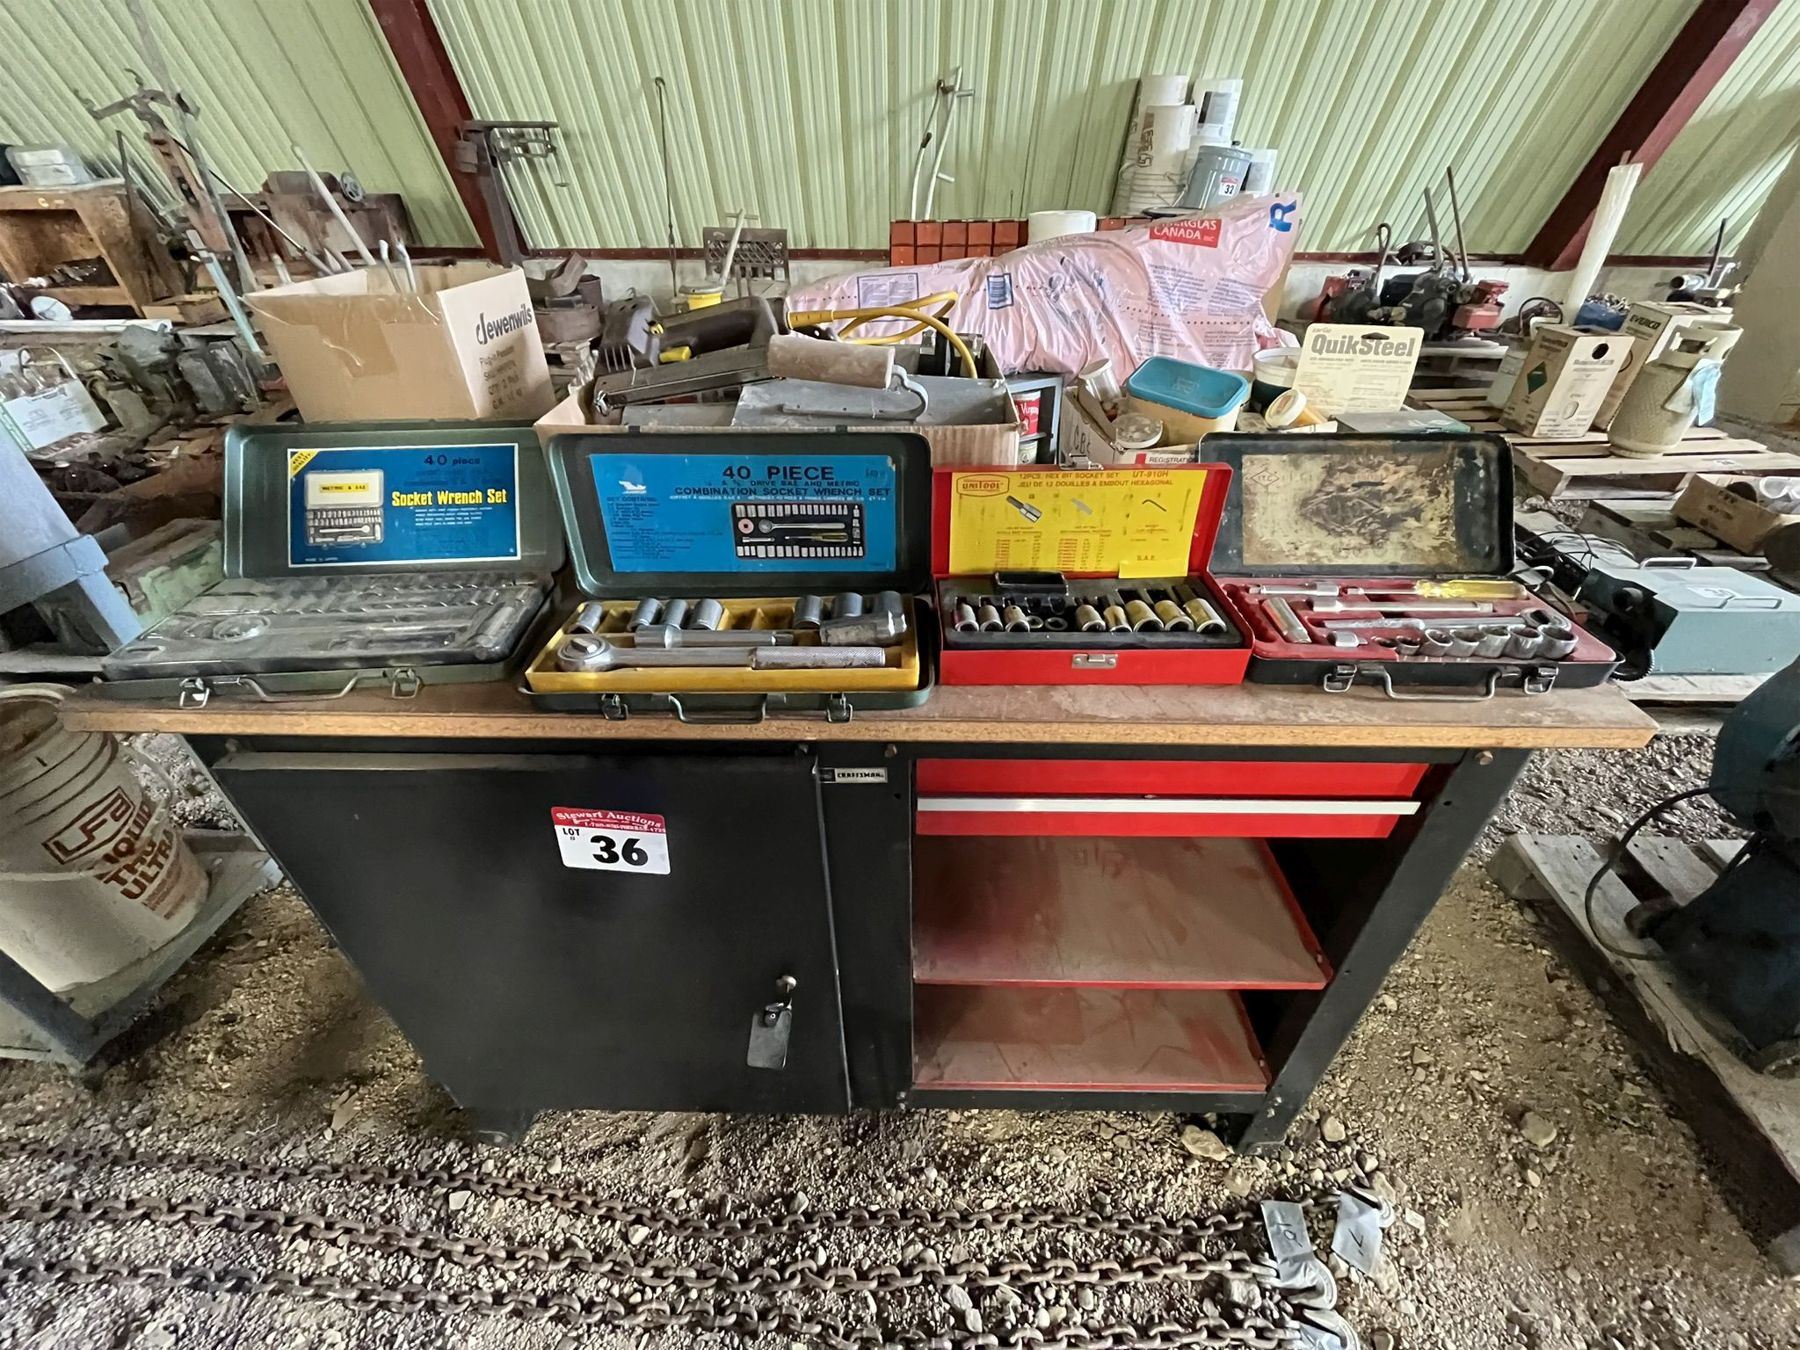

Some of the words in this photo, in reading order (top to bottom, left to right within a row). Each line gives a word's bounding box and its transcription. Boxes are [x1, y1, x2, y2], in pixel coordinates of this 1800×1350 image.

[1153, 226, 1201, 240] CANADA
[1162, 219, 1217, 231] RGLAS
[1311, 333, 1417, 357] QuikSteel
[722, 465, 751, 480] 40
[767, 466, 835, 480] PIECE
[391, 490, 433, 507] Socket
[436, 489, 483, 505] Wrench
[486, 488, 508, 504] Set
[675, 486, 757, 496] COMBINATION
[763, 487, 808, 496] SOCKET
[813, 487, 862, 496] WRENCH
[868, 487, 892, 496] SET
[556, 811, 603, 820] Stewart
[606, 811, 662, 828] Auctions
[562, 827, 580, 836] LOT
[590, 834, 649, 867] 36
[120, 828, 174, 900] ULTRA
